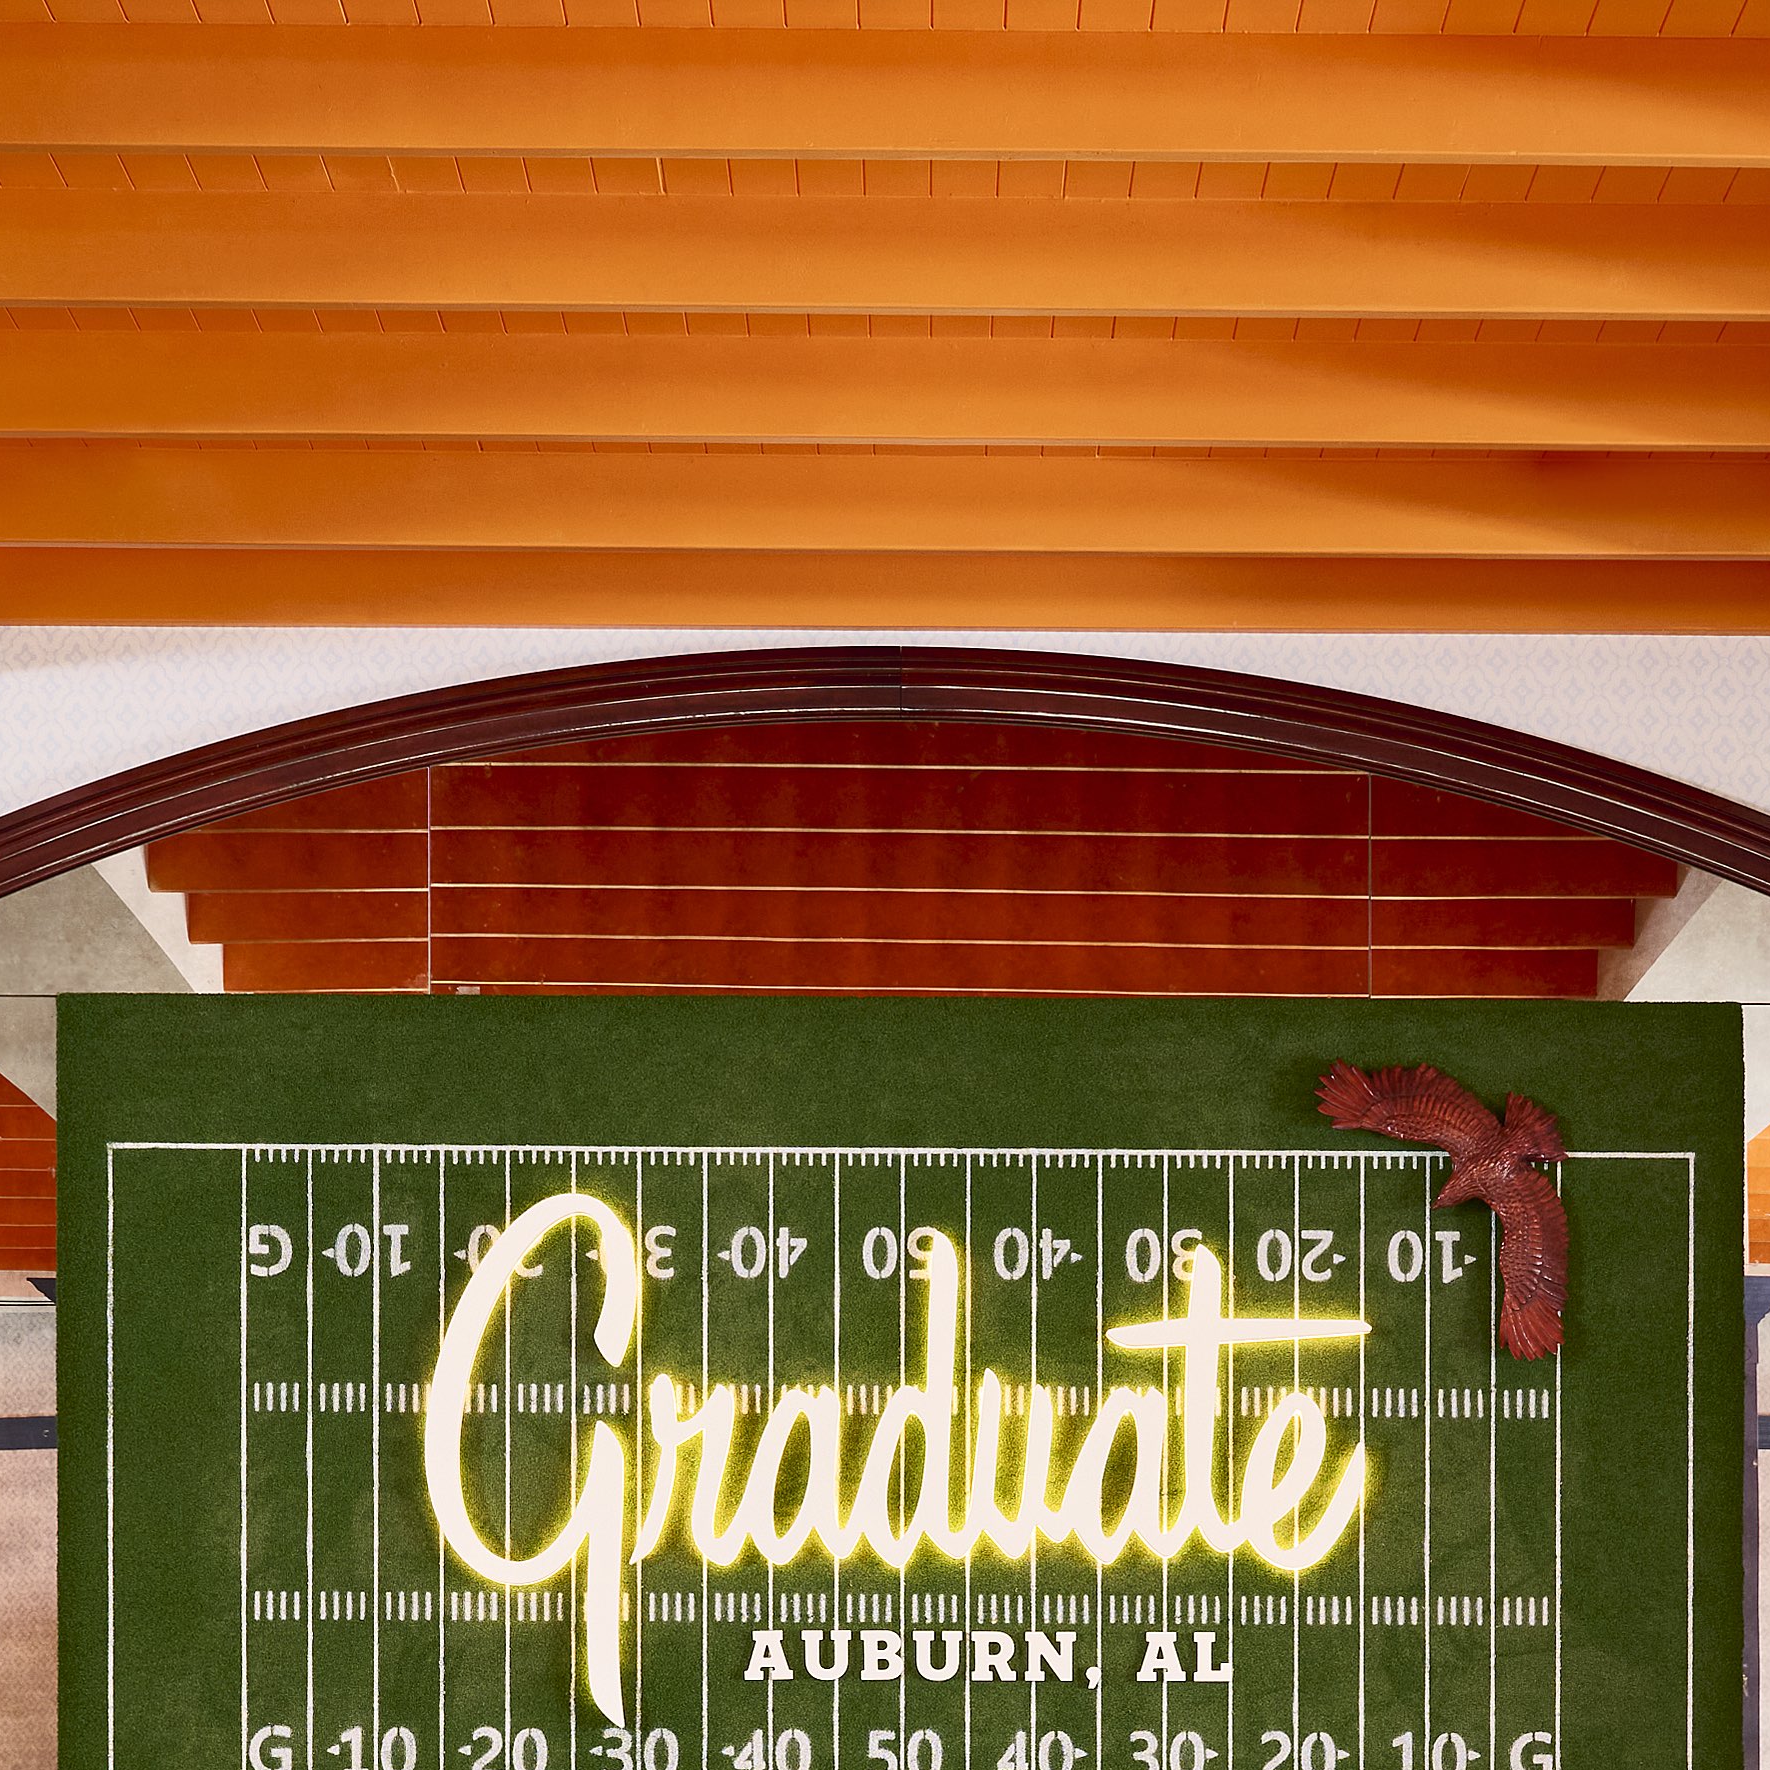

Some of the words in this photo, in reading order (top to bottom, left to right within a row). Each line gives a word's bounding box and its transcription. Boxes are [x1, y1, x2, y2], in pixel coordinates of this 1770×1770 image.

[425, 1193, 1372, 1727] Graduate
[744, 1630, 1101, 1690] AUBURN,
[1136, 1631, 1232, 1683] AL
